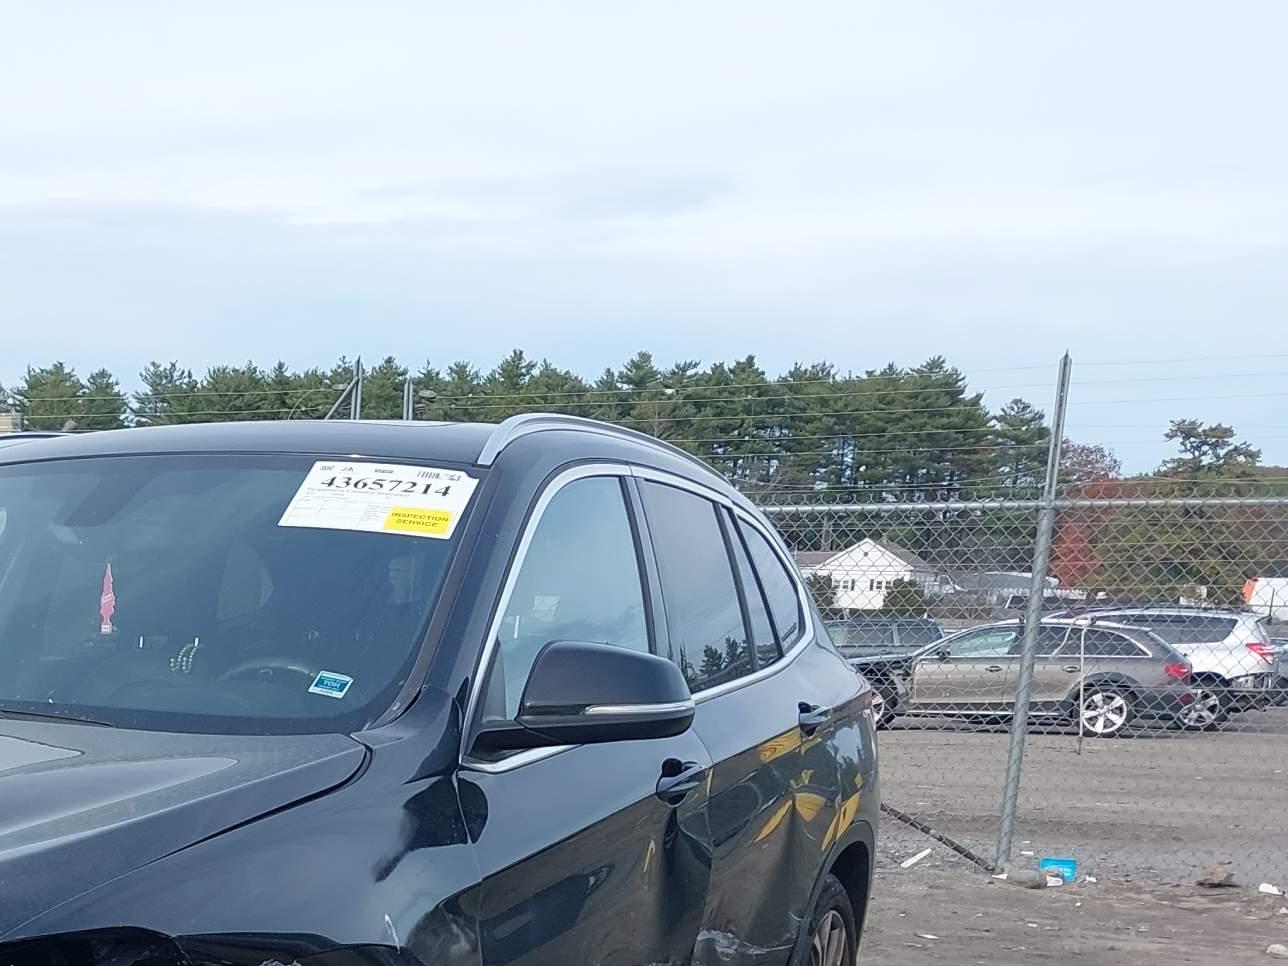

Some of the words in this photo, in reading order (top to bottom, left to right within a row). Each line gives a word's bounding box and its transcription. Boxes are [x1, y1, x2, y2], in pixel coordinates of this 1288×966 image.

[320, 475, 453, 498] 43657214
[391, 511, 450, 523] INSPECTION
[394, 518, 440, 528] SERVICE
